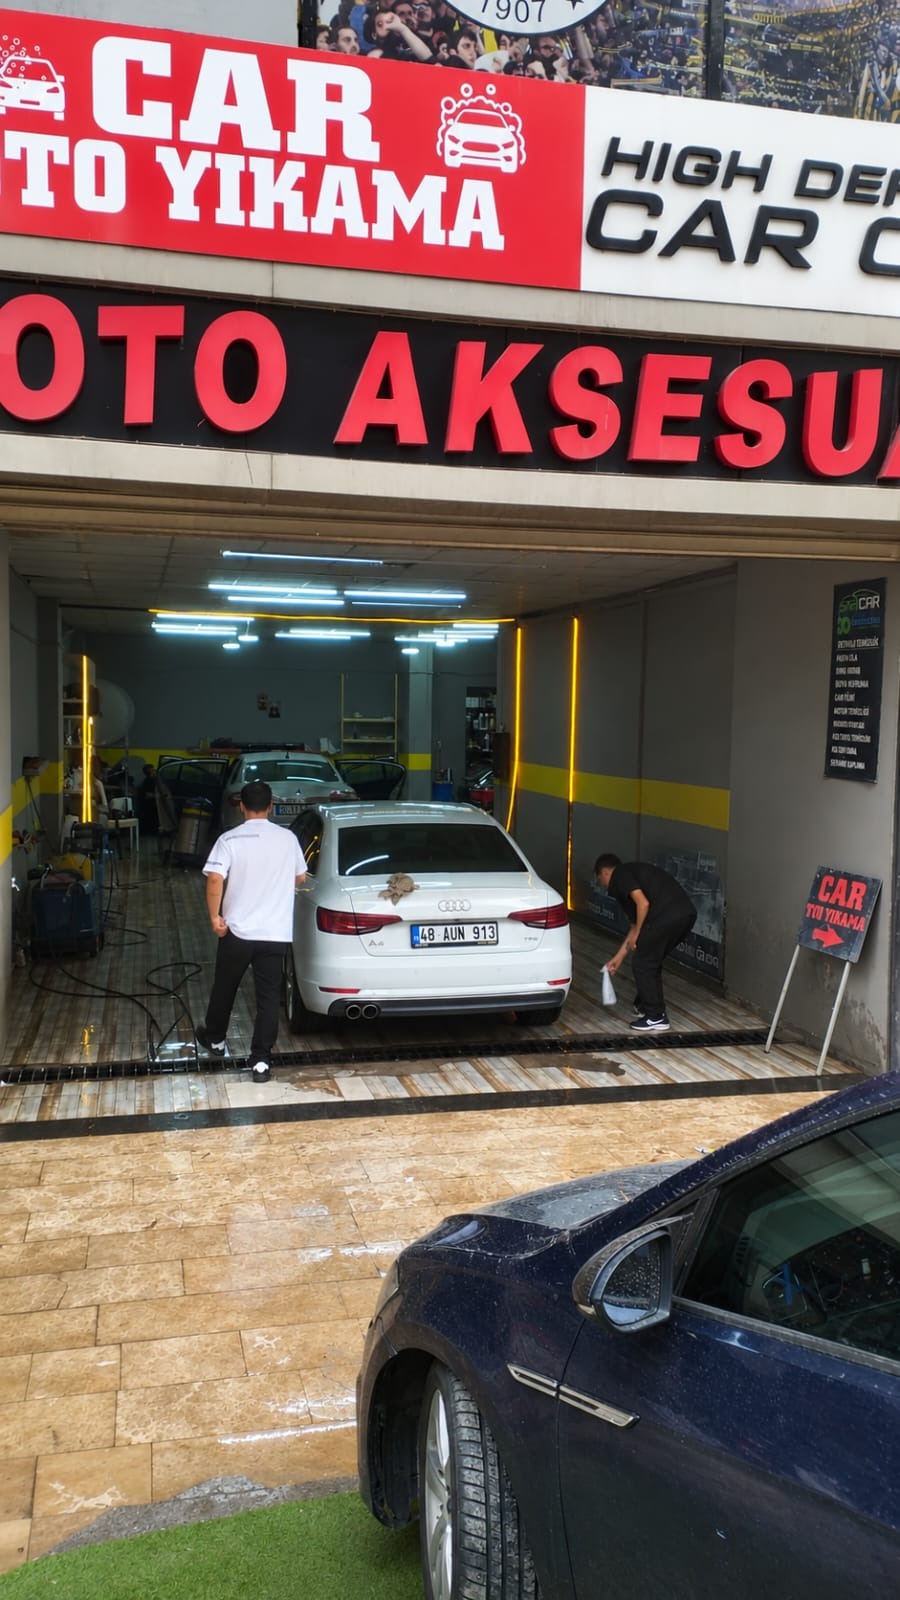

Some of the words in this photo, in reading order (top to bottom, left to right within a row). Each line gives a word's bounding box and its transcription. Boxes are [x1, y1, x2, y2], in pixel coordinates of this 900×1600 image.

[91, 36, 381, 163] CAR
[0, 130, 126, 214] TO
[154, 146, 506, 252] YIKAMA
[601, 136, 772, 194] HIGH
[585, 188, 820, 270] CAR
[0, 294, 287, 433] OTO
[333, 330, 900, 479] AKSESU
[817, 874, 867, 911] CAR
[824, 907, 866, 932] YIKAMA
[420, 927, 435, 942] 48
[443, 926, 465, 942] AUN
[472, 925, 495, 940] 913
